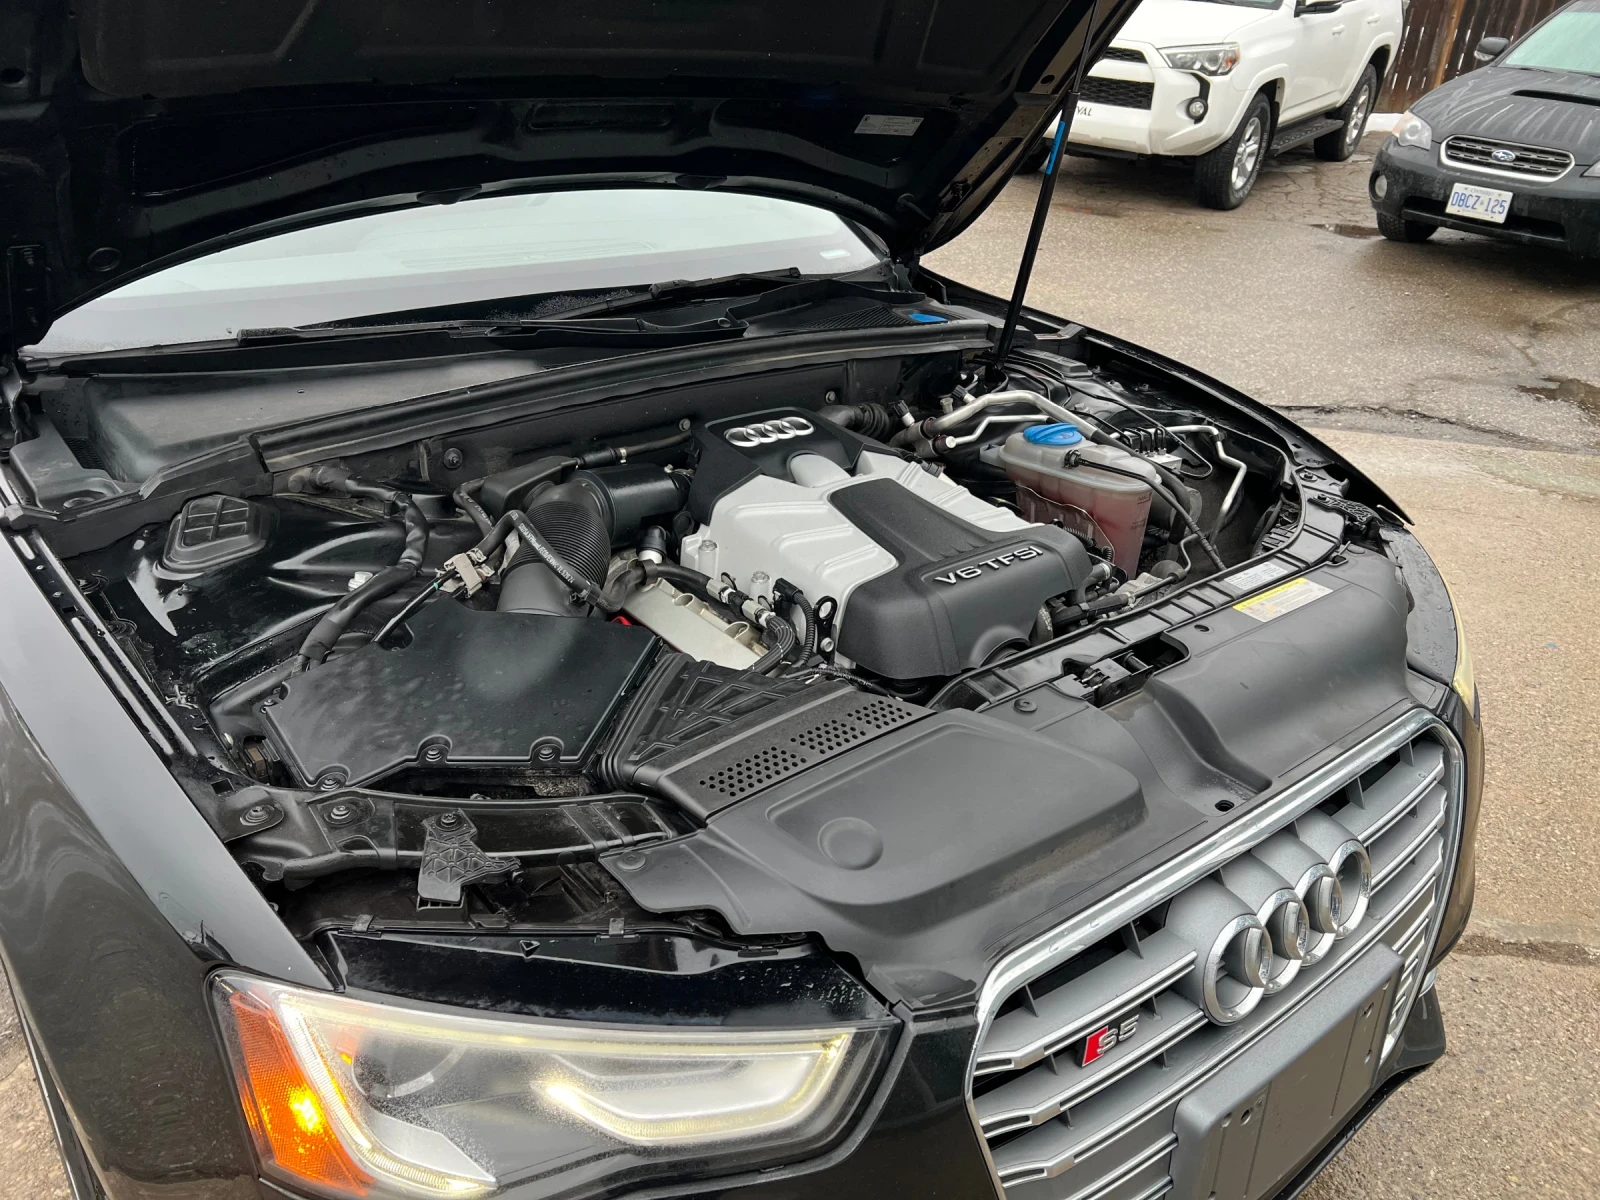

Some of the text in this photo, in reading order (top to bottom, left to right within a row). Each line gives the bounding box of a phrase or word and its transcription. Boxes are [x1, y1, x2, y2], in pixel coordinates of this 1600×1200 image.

[933, 545, 1044, 585] V6 TFSI
[1096, 1014, 1139, 1055] S5
